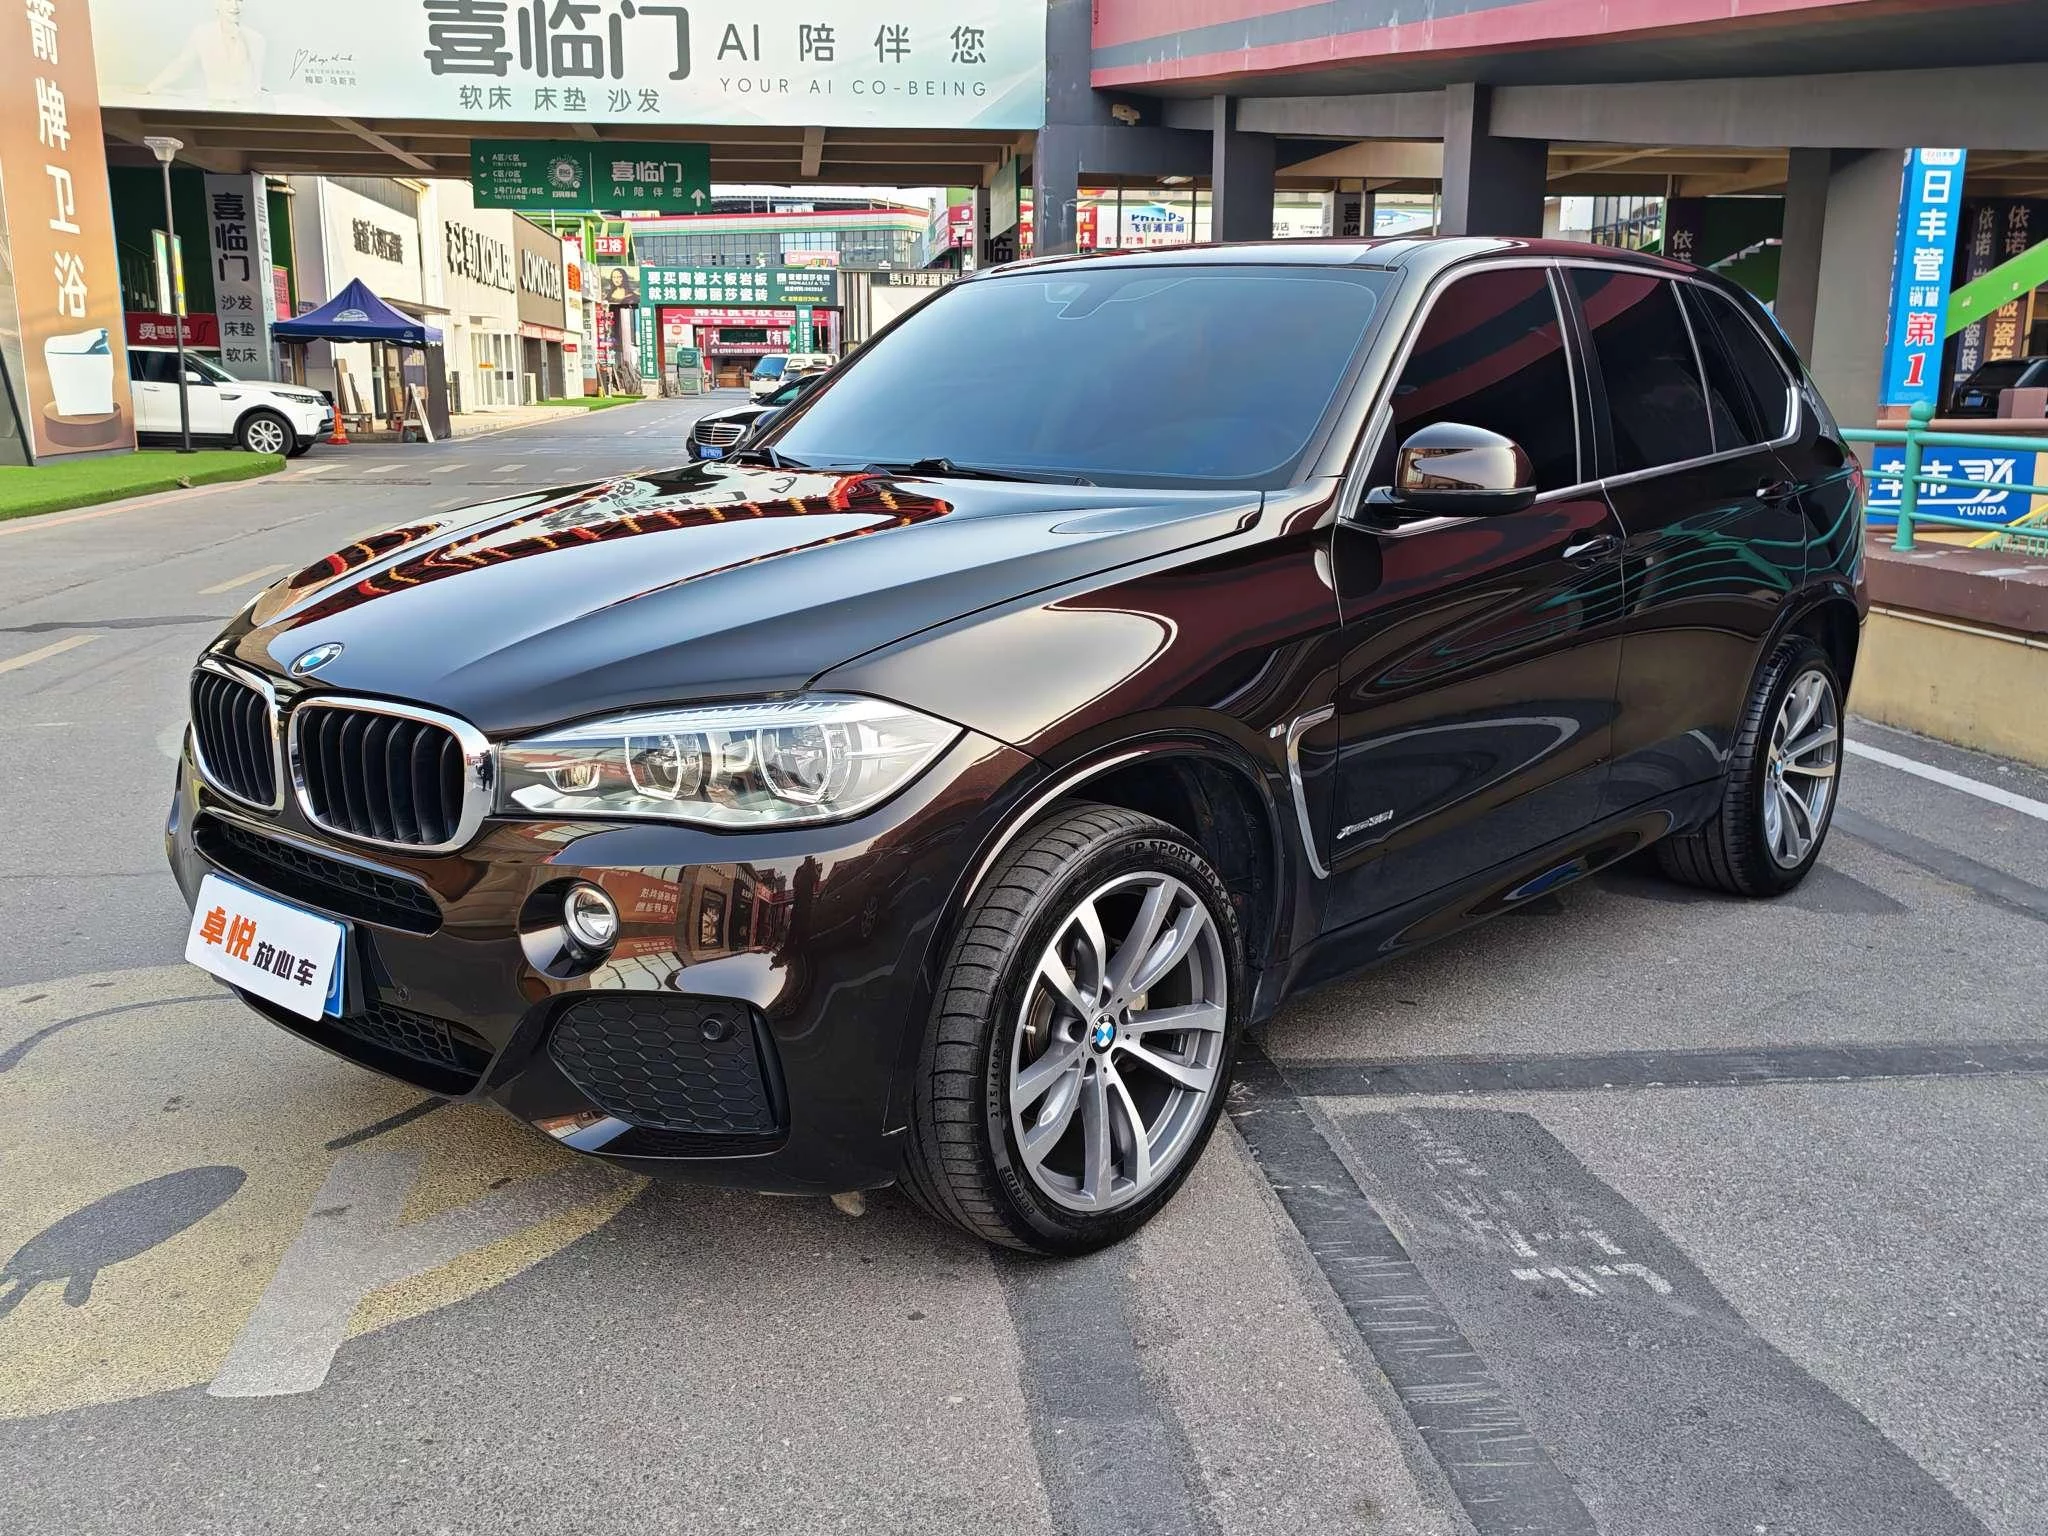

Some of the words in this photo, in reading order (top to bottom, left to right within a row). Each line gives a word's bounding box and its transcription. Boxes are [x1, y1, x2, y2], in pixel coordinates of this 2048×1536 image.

[423, 0, 691, 81] 喜临门
[717, 23, 760, 62] AI
[799, 22, 986, 65] 陪伴您
[720, 77, 789, 93] YOUR
[809, 79, 832, 94] AI
[852, 79, 986, 97] CO-BEING
[460, 84, 512, 110] 软床
[534, 86, 587, 112] 床垫
[608, 87, 661, 113] 沙发
[26, 0, 88, 318] 箭牌卫浴
[611, 160, 682, 184] 喜临门
[612, 186, 625, 197] AI
[633, 186, 683, 198] 陪伴您
[1914, 169, 1952, 281] 日丰管
[212, 192, 250, 282] 喜临门
[647, 271, 768, 286] 要买陶瓷大板岩板
[221, 295, 254, 311] 沙发
[648, 286, 768, 302] 就找蒙娜丽莎瓷砖
[224, 321, 256, 337] 床垫
[226, 347, 258, 363] 软床
[1957, 505, 2007, 517] YUNDA
[199, 905, 257, 963] 卓悦
[252, 940, 317, 987] 放心车
